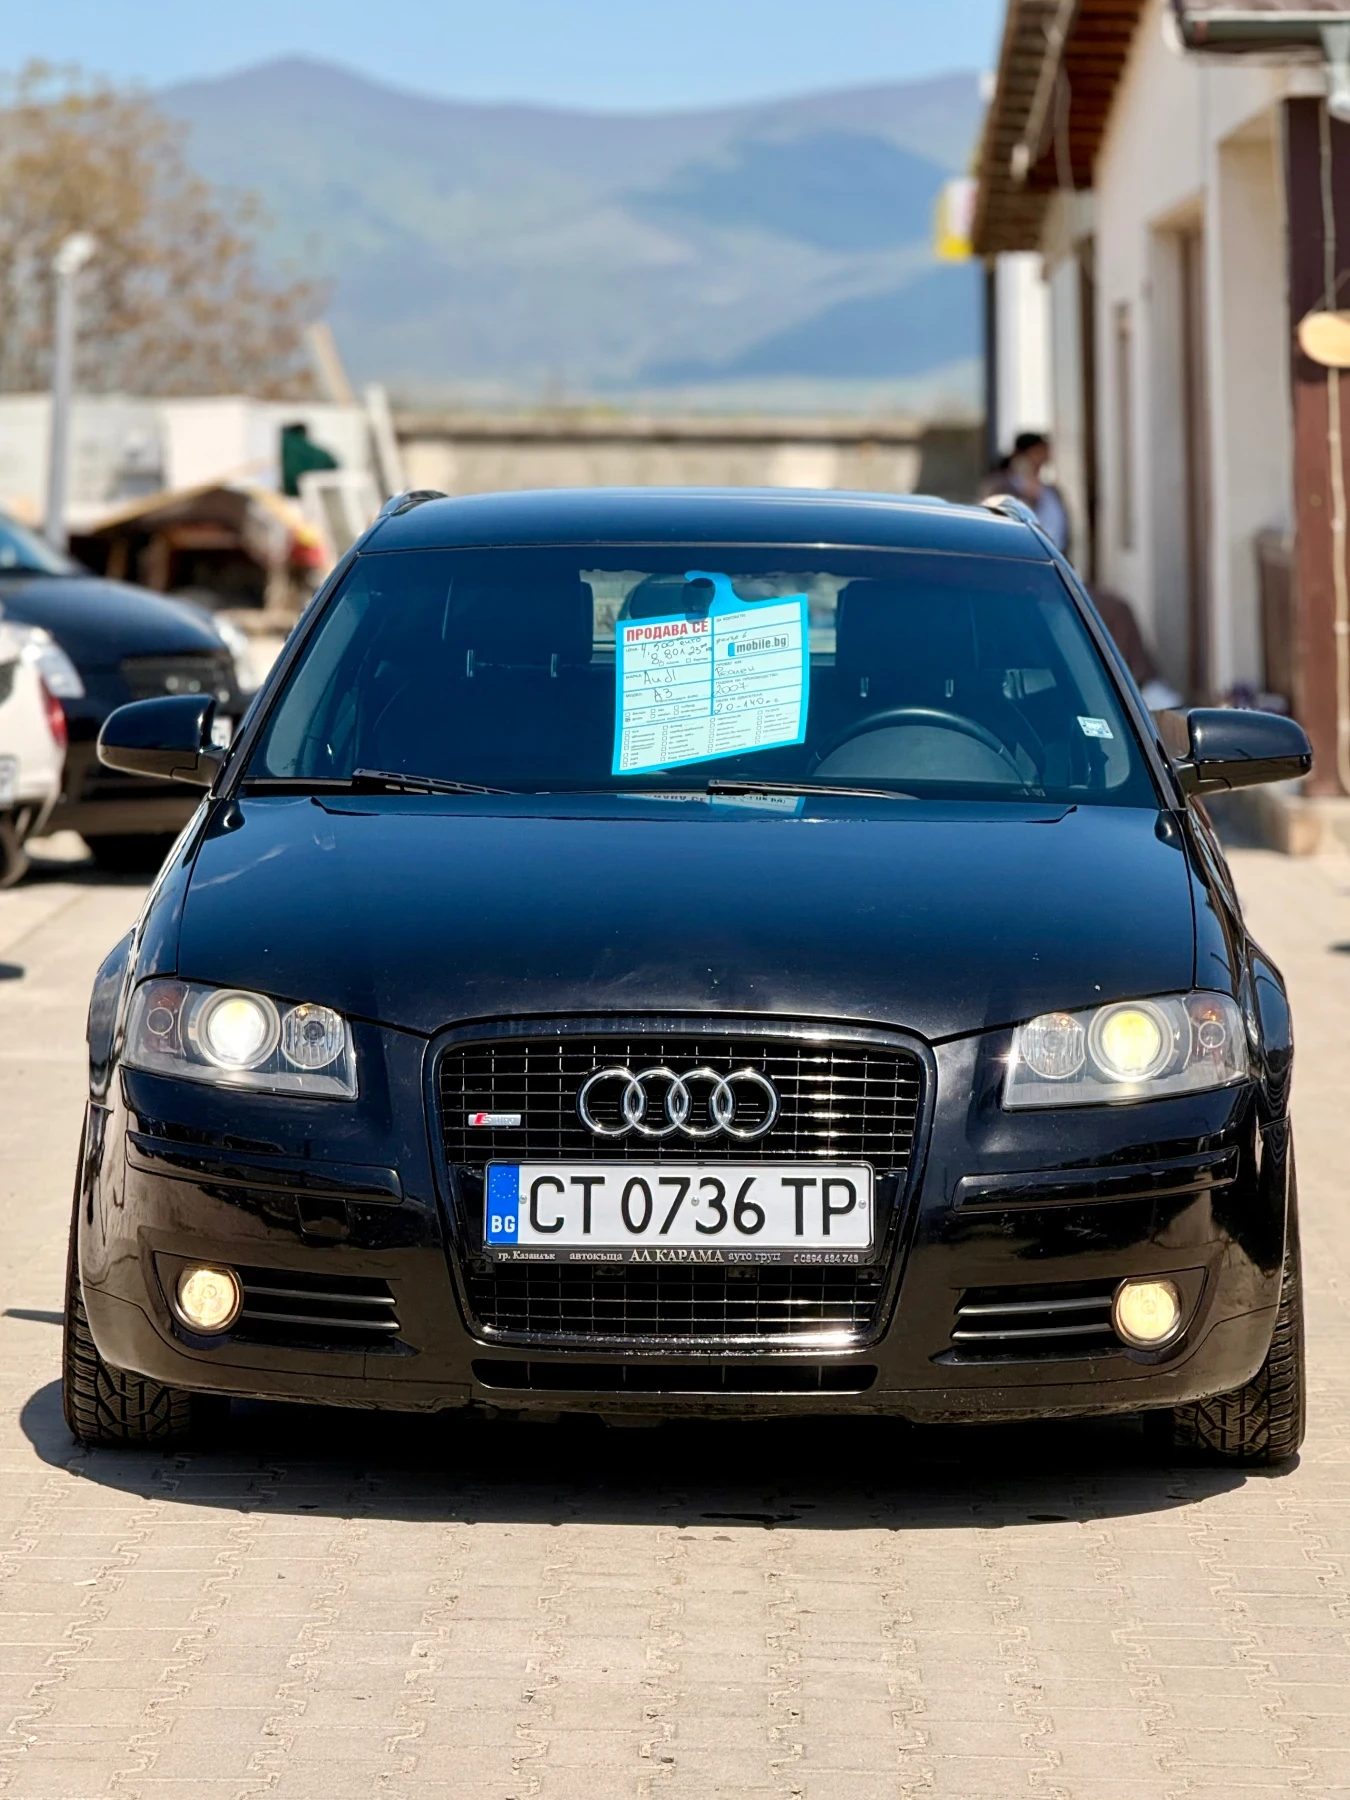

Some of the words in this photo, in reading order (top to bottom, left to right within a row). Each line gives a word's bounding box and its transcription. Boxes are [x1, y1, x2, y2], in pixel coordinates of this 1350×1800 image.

[626, 623, 688, 642] ПРОДАВА
[692, 620, 709, 633] СЕ
[736, 636, 787, 653] mobile.bg
[529, 1175, 606, 1235] CT
[620, 1176, 766, 1235] 0736
[780, 1177, 858, 1236] TP
[490, 1215, 516, 1233] BG
[498, 1251, 511, 1261] гр.
[512, 1250, 556, 1260] Казанлък
[569, 1252, 623, 1261] автокъща
[655, 1249, 725, 1263] КАРАМА
[728, 1252, 752, 1264] ауто
[755, 1252, 781, 1264] груп
